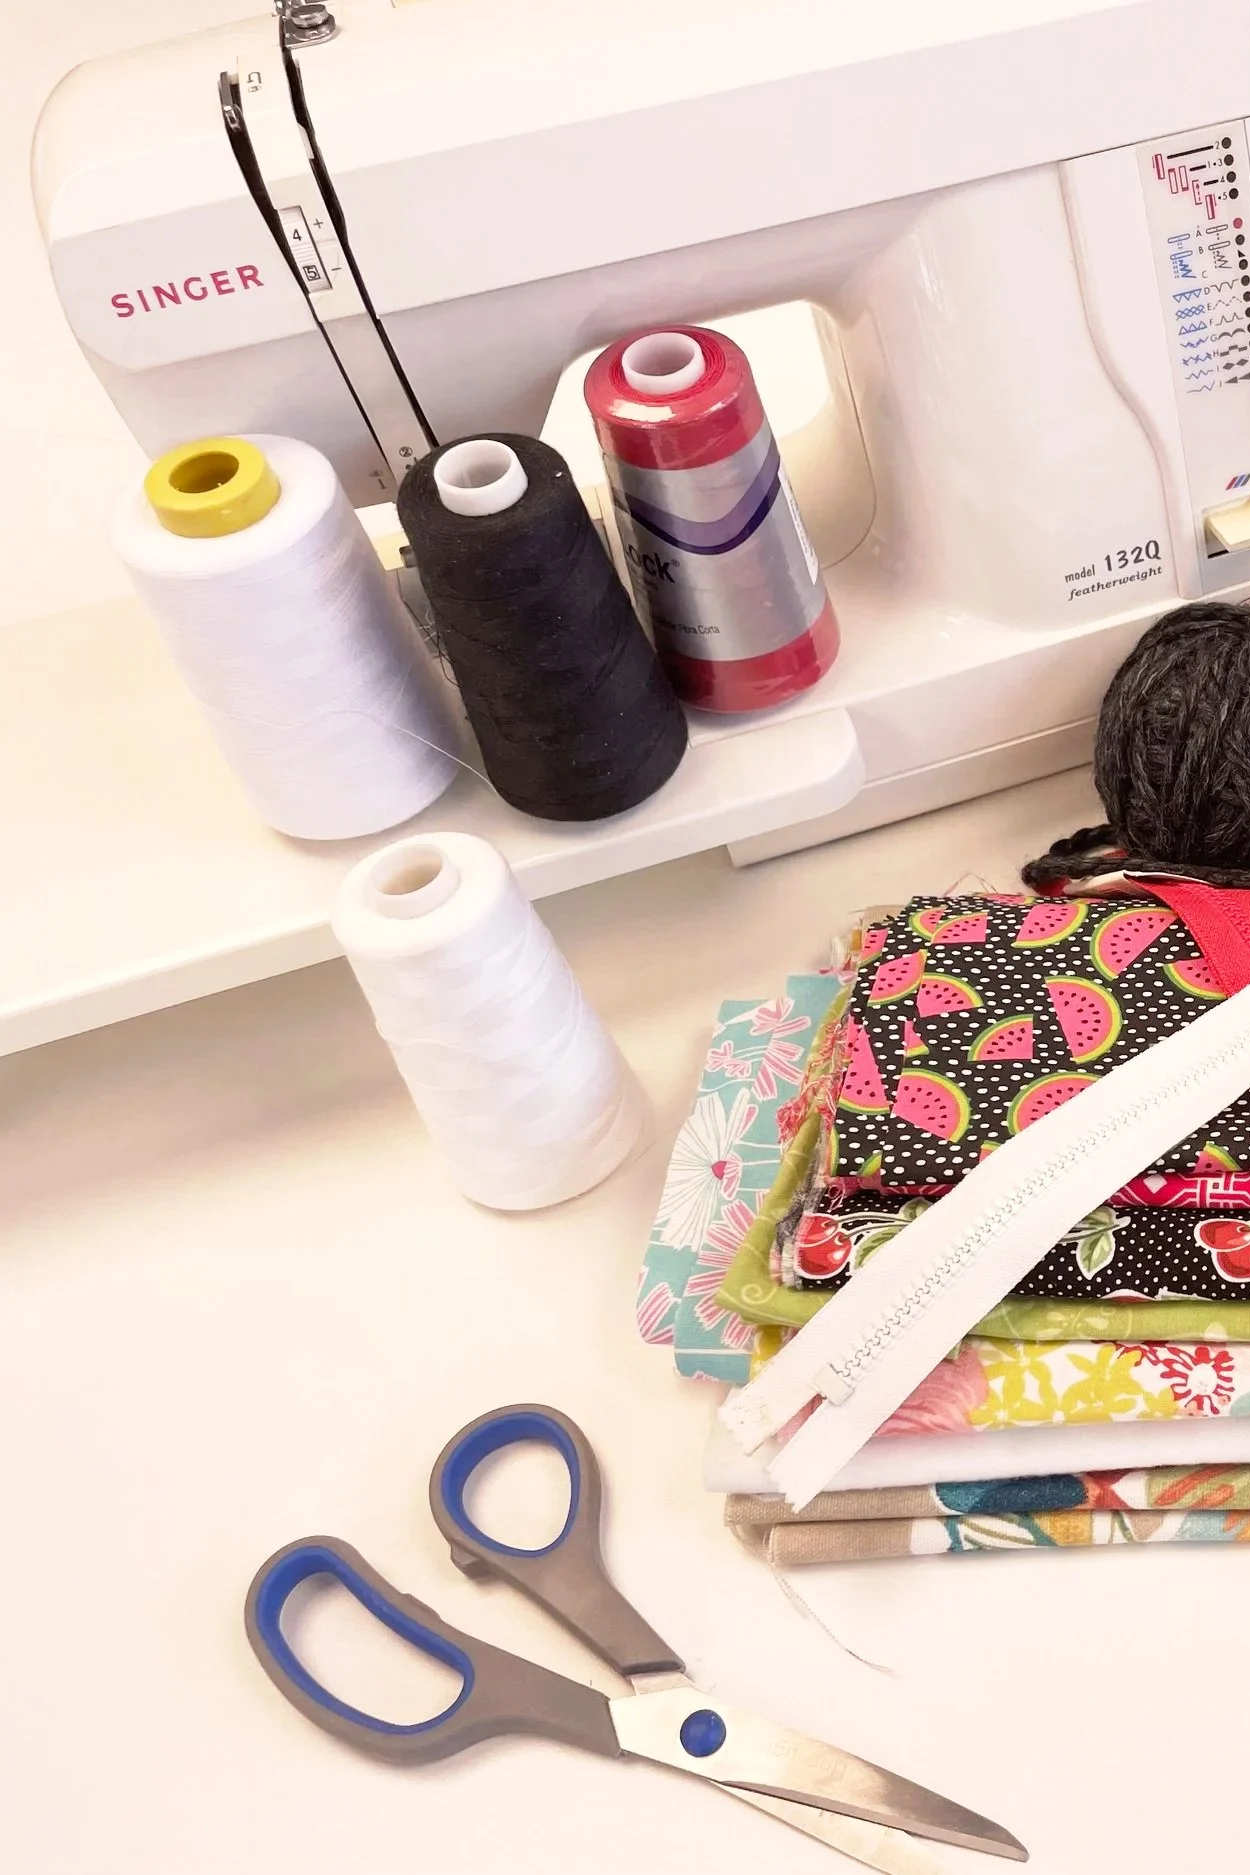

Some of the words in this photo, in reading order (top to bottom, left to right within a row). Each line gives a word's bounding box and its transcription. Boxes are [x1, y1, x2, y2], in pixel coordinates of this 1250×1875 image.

[1215, 141, 1220, 150] 2
[1220, 175, 1226, 183] 4
[1222, 192, 1228, 200] 5
[292, 228, 302, 241] 4
[1195, 230, 1203, 238] A
[1198, 246, 1204, 255] B
[305, 266, 319, 279] 5
[1201, 270, 1208, 279] C
[111, 264, 264, 318] SINGER
[1203, 286, 1211, 295] D
[1207, 303, 1212, 311] E
[1209, 318, 1214, 326] F
[1210, 334, 1218, 343] G
[1212, 349, 1220, 358] H
[1064, 564, 1096, 583] model
[1104, 540, 1162, 572] 132Q
[1068, 566, 1163, 601] featherweight
